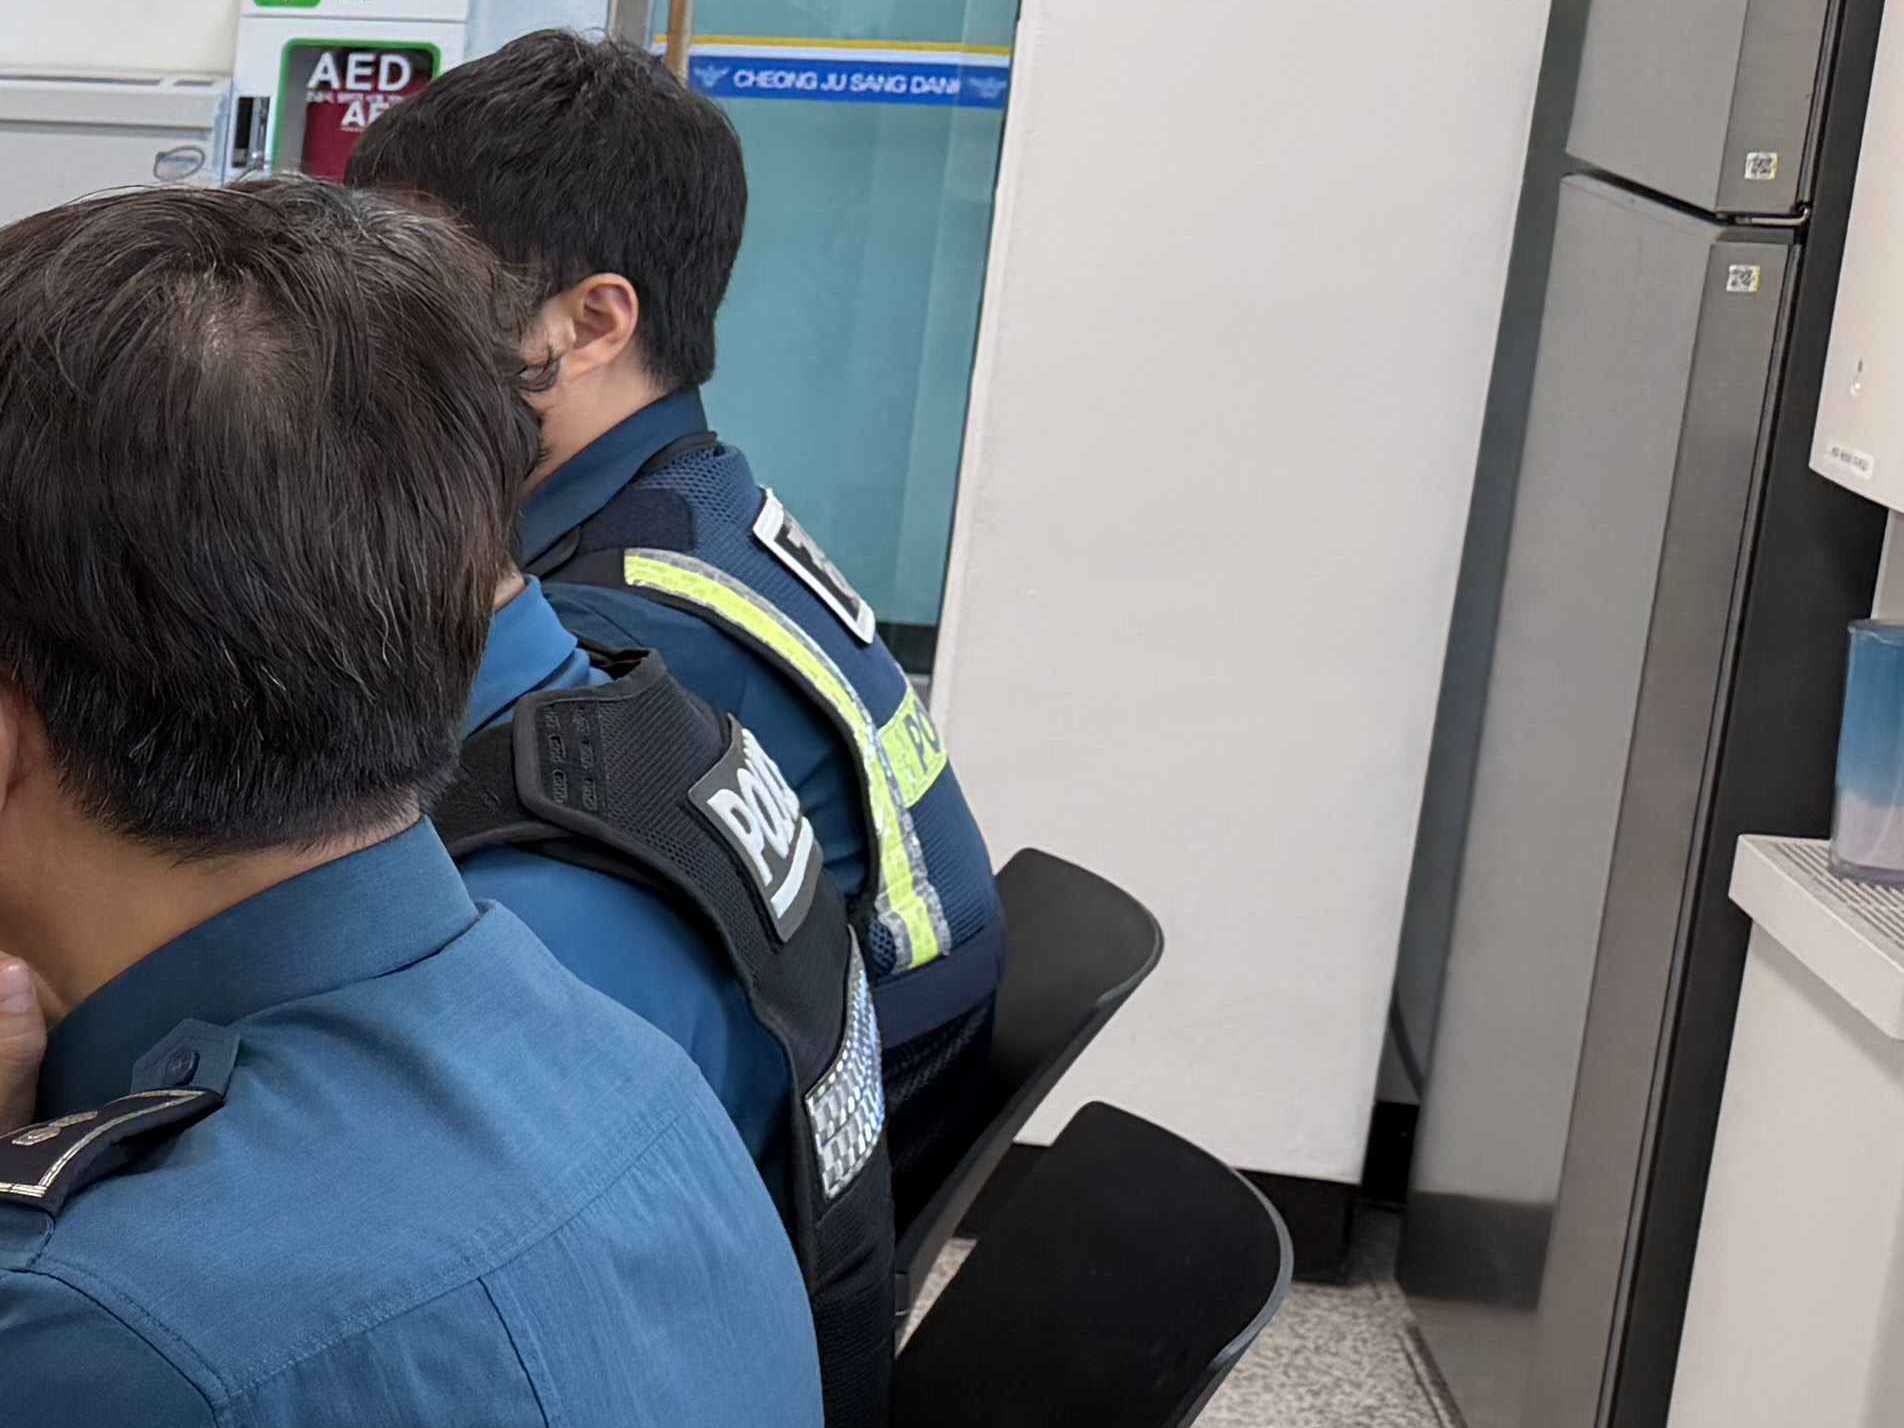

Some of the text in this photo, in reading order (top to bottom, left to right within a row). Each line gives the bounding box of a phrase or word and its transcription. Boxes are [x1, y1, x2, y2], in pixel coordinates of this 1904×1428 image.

[307, 51, 411, 91] AED
[733, 68, 817, 92] CHEONG
[820, 73, 844, 92] JU
[850, 74, 907, 93] SANG
